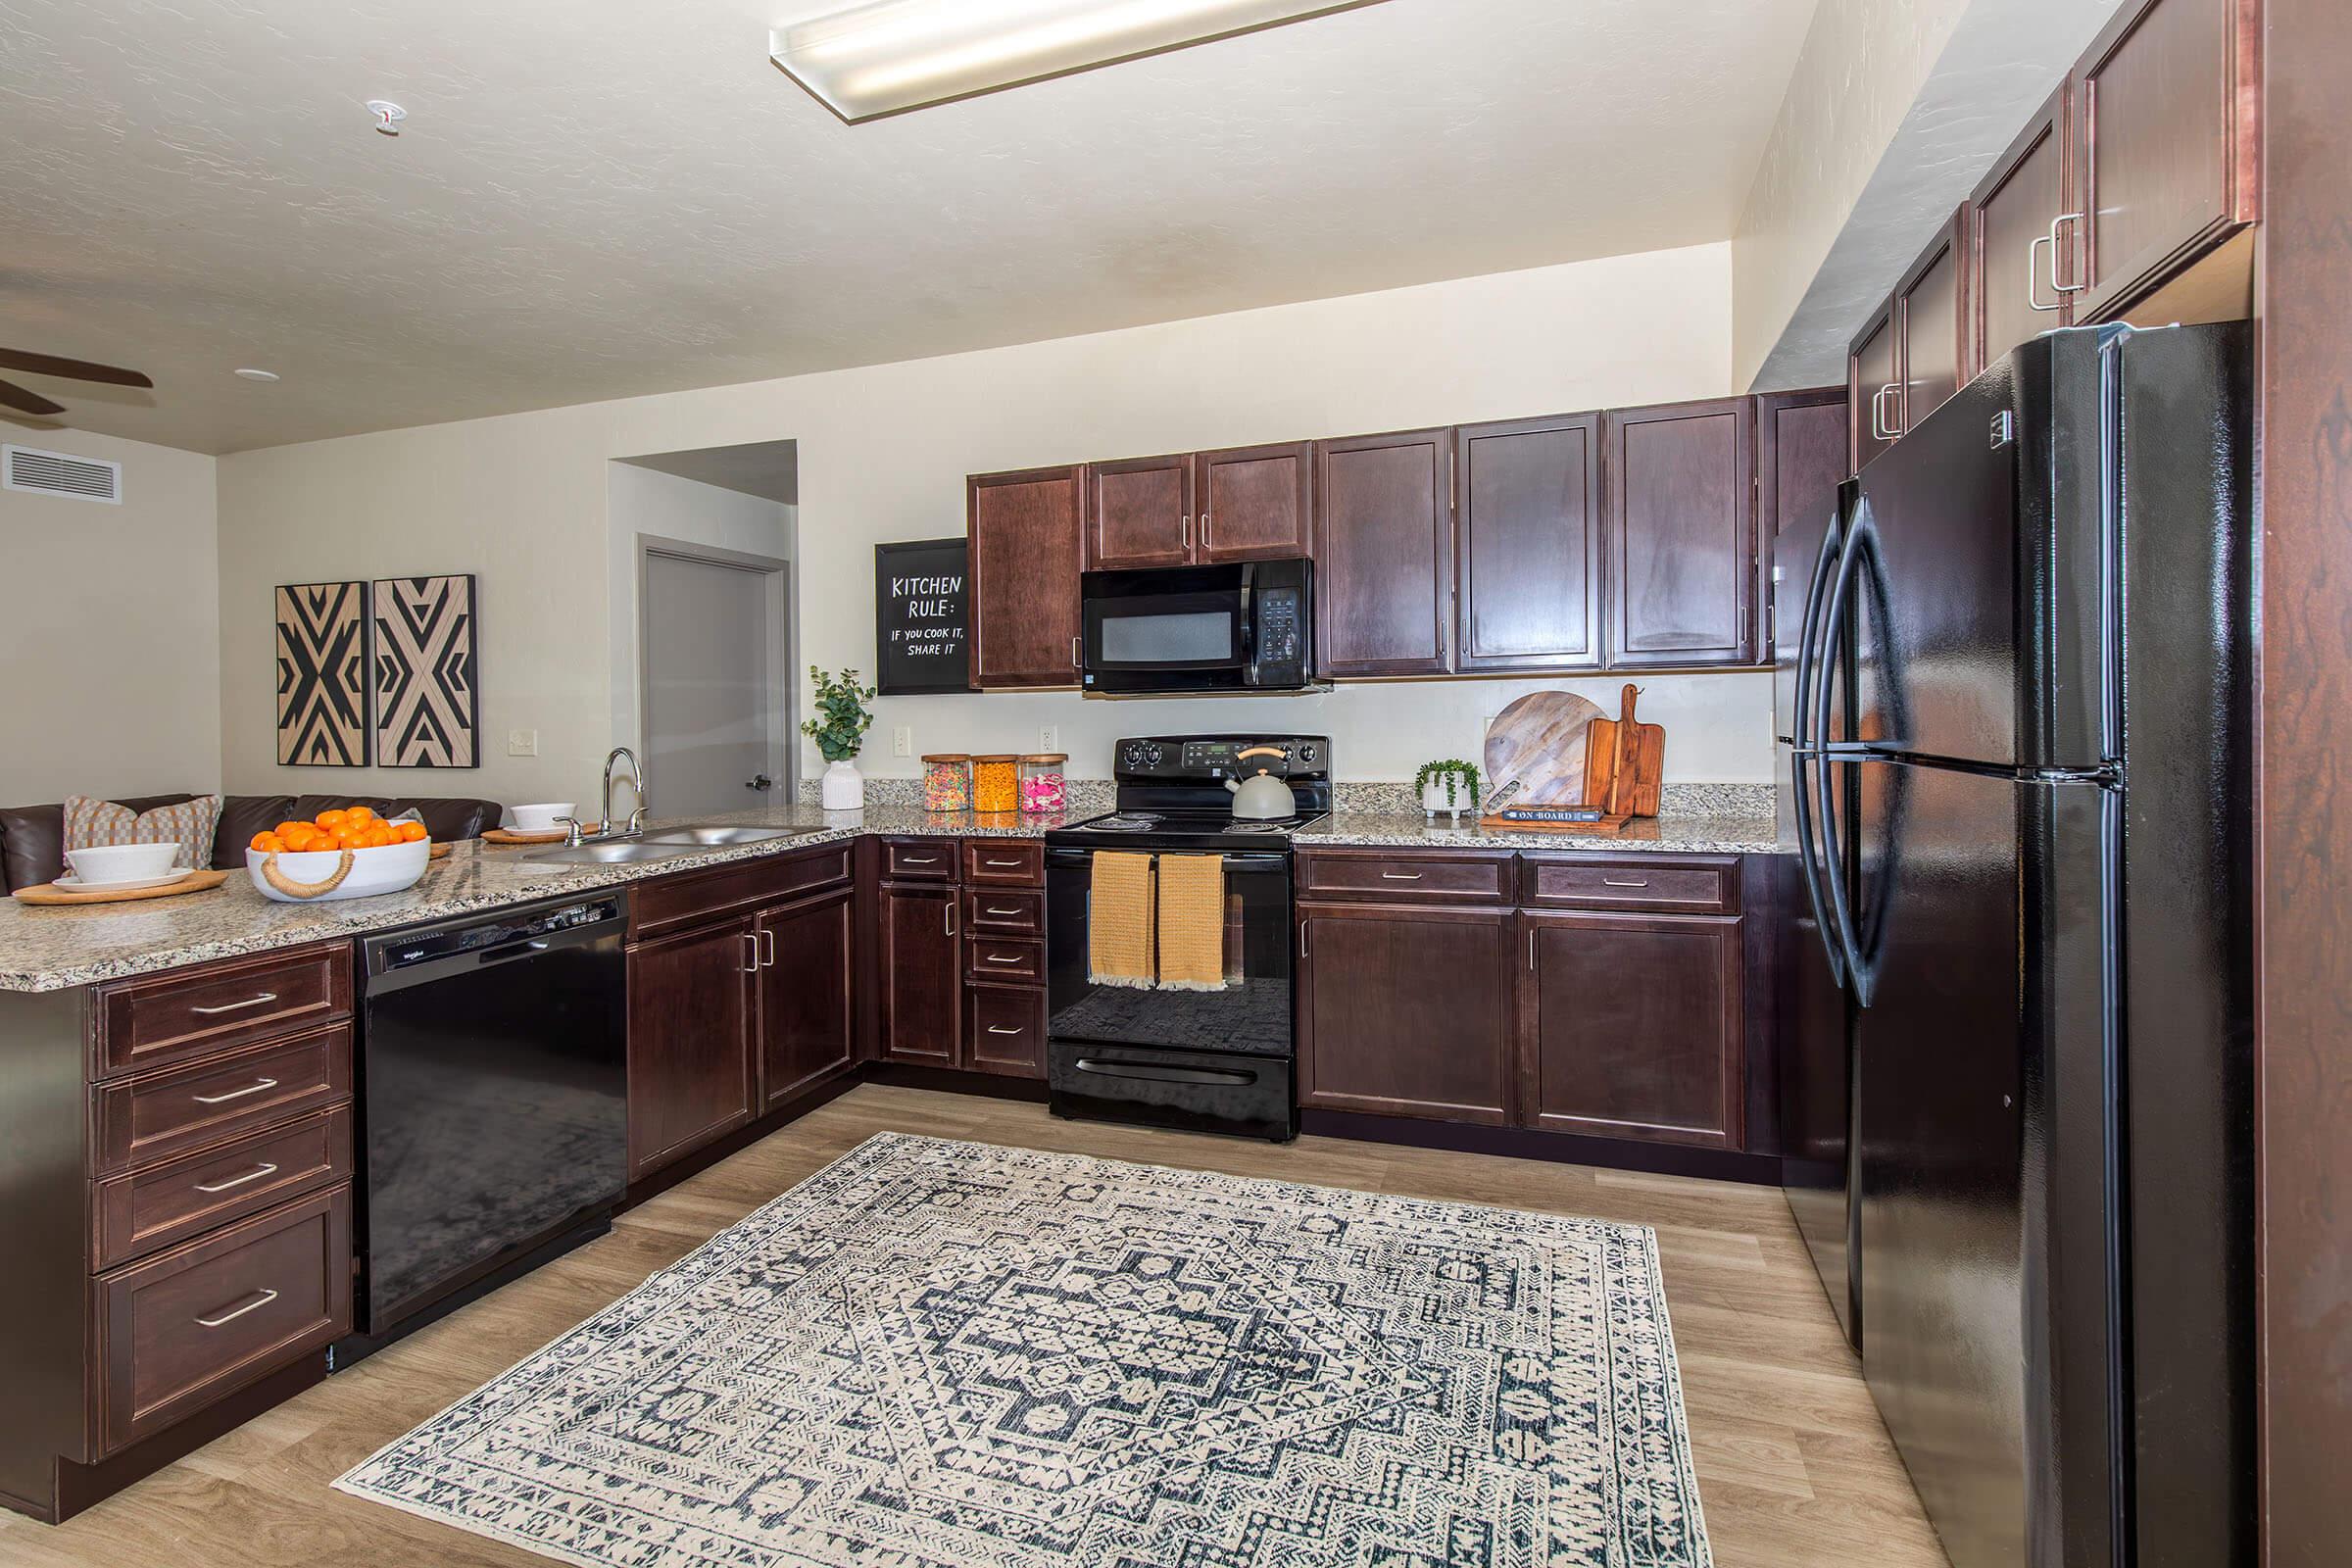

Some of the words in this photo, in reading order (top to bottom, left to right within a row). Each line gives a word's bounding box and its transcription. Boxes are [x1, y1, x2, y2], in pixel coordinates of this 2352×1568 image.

[892, 576, 961, 598] KITCHEN
[908, 600, 955, 618] RULE:
[891, 630, 901, 642] IF
[905, 628, 922, 640] YOU
[924, 627, 950, 639] COOK
[952, 627, 963, 640] IT,
[907, 644, 941, 656] SHARE
[944, 643, 955, 655] IT
[1536, 811, 1572, 820] BOARD
